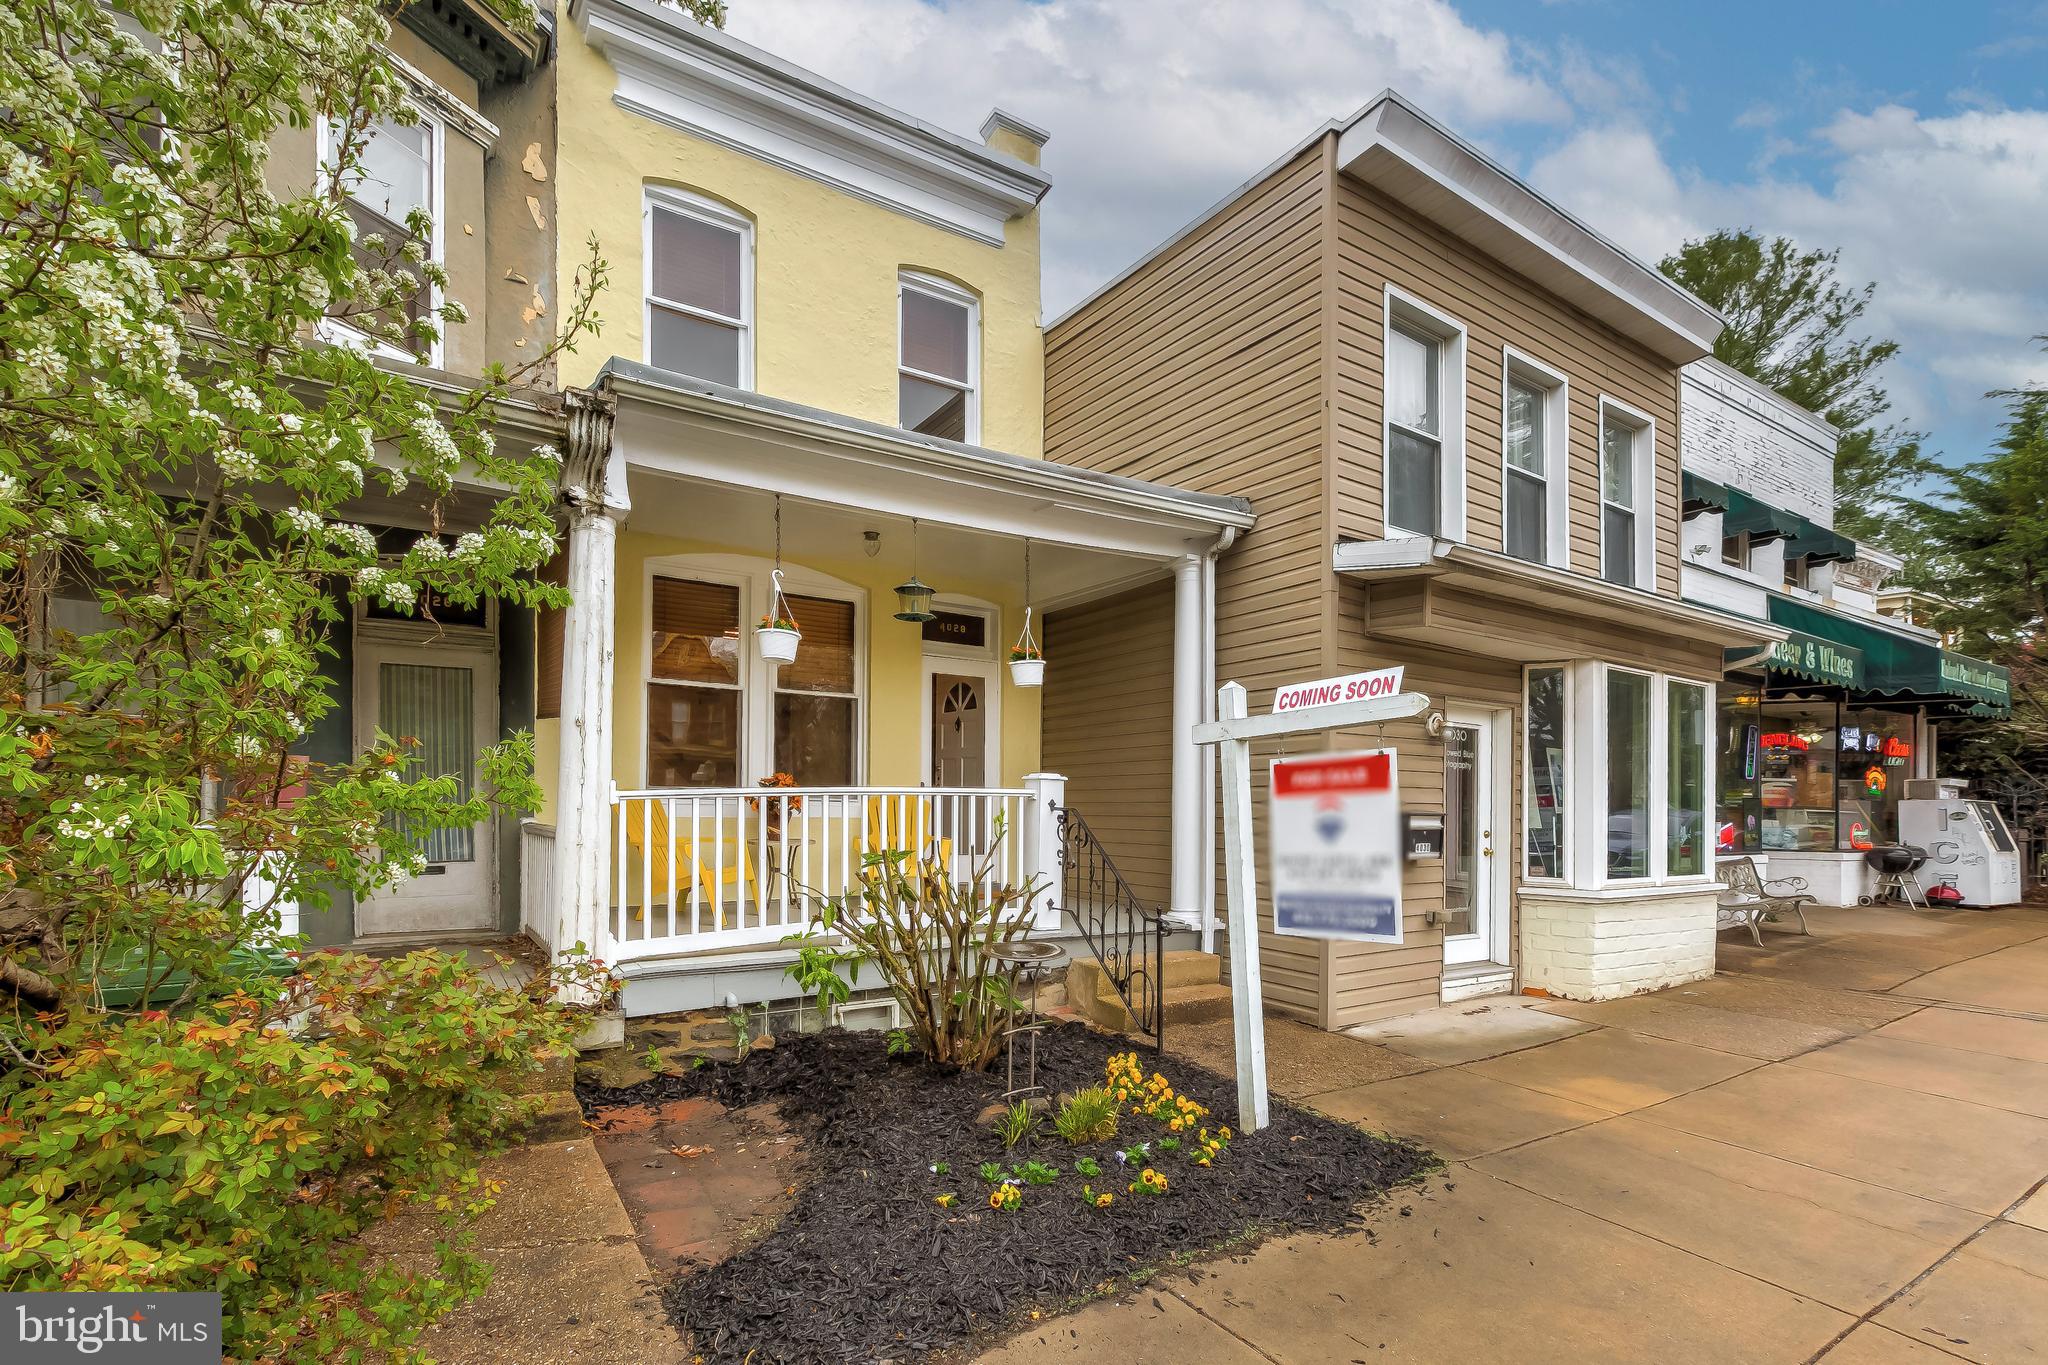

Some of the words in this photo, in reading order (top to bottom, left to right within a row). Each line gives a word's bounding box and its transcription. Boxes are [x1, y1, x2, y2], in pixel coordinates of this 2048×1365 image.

[1805, 641, 1816, 669] &
[1819, 645, 1854, 679] Wines
[1279, 684, 1342, 710] COMING
[1345, 675, 1396, 700] SOON
